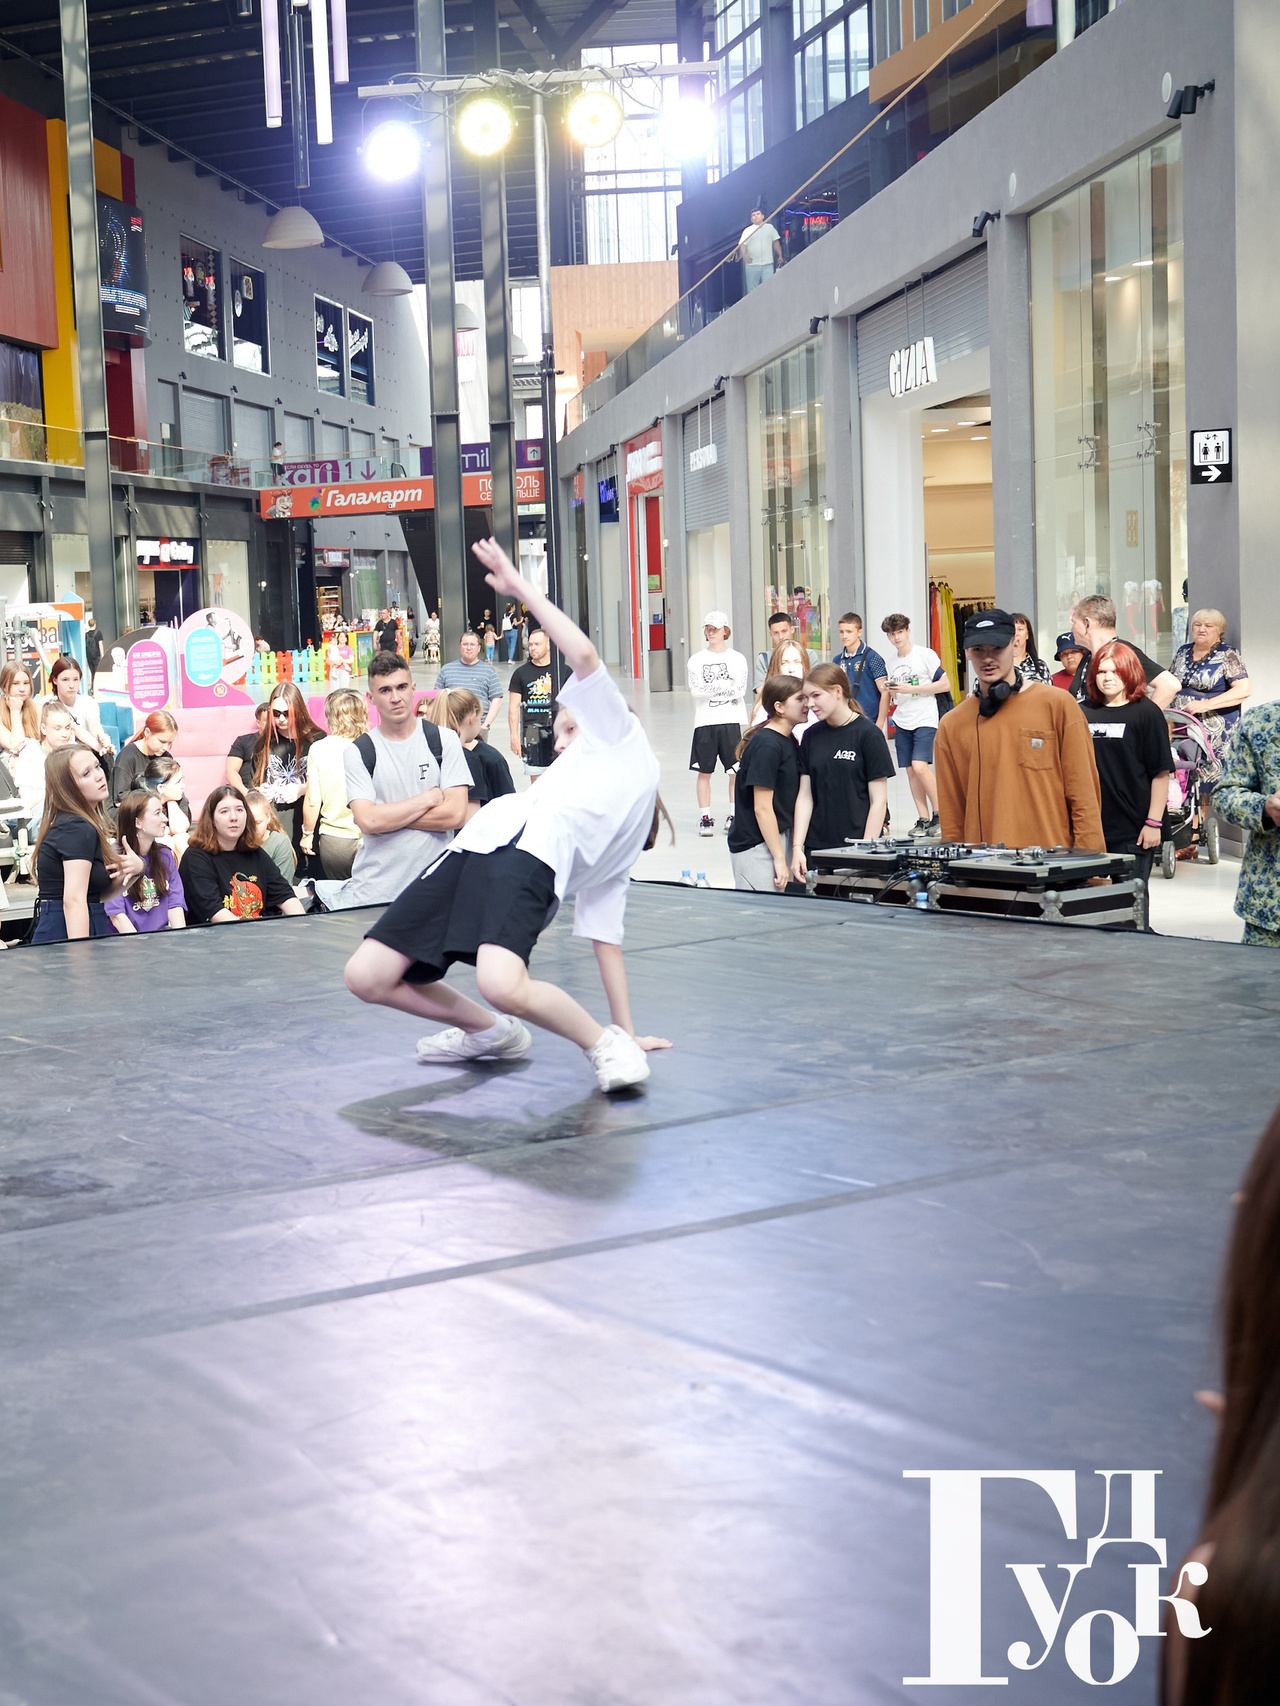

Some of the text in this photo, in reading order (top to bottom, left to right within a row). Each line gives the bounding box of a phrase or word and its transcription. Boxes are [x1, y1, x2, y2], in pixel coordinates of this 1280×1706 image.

[326, 488, 422, 508] Галамарт
[833, 749, 857, 761] AGR
[419, 763, 430, 780] F
